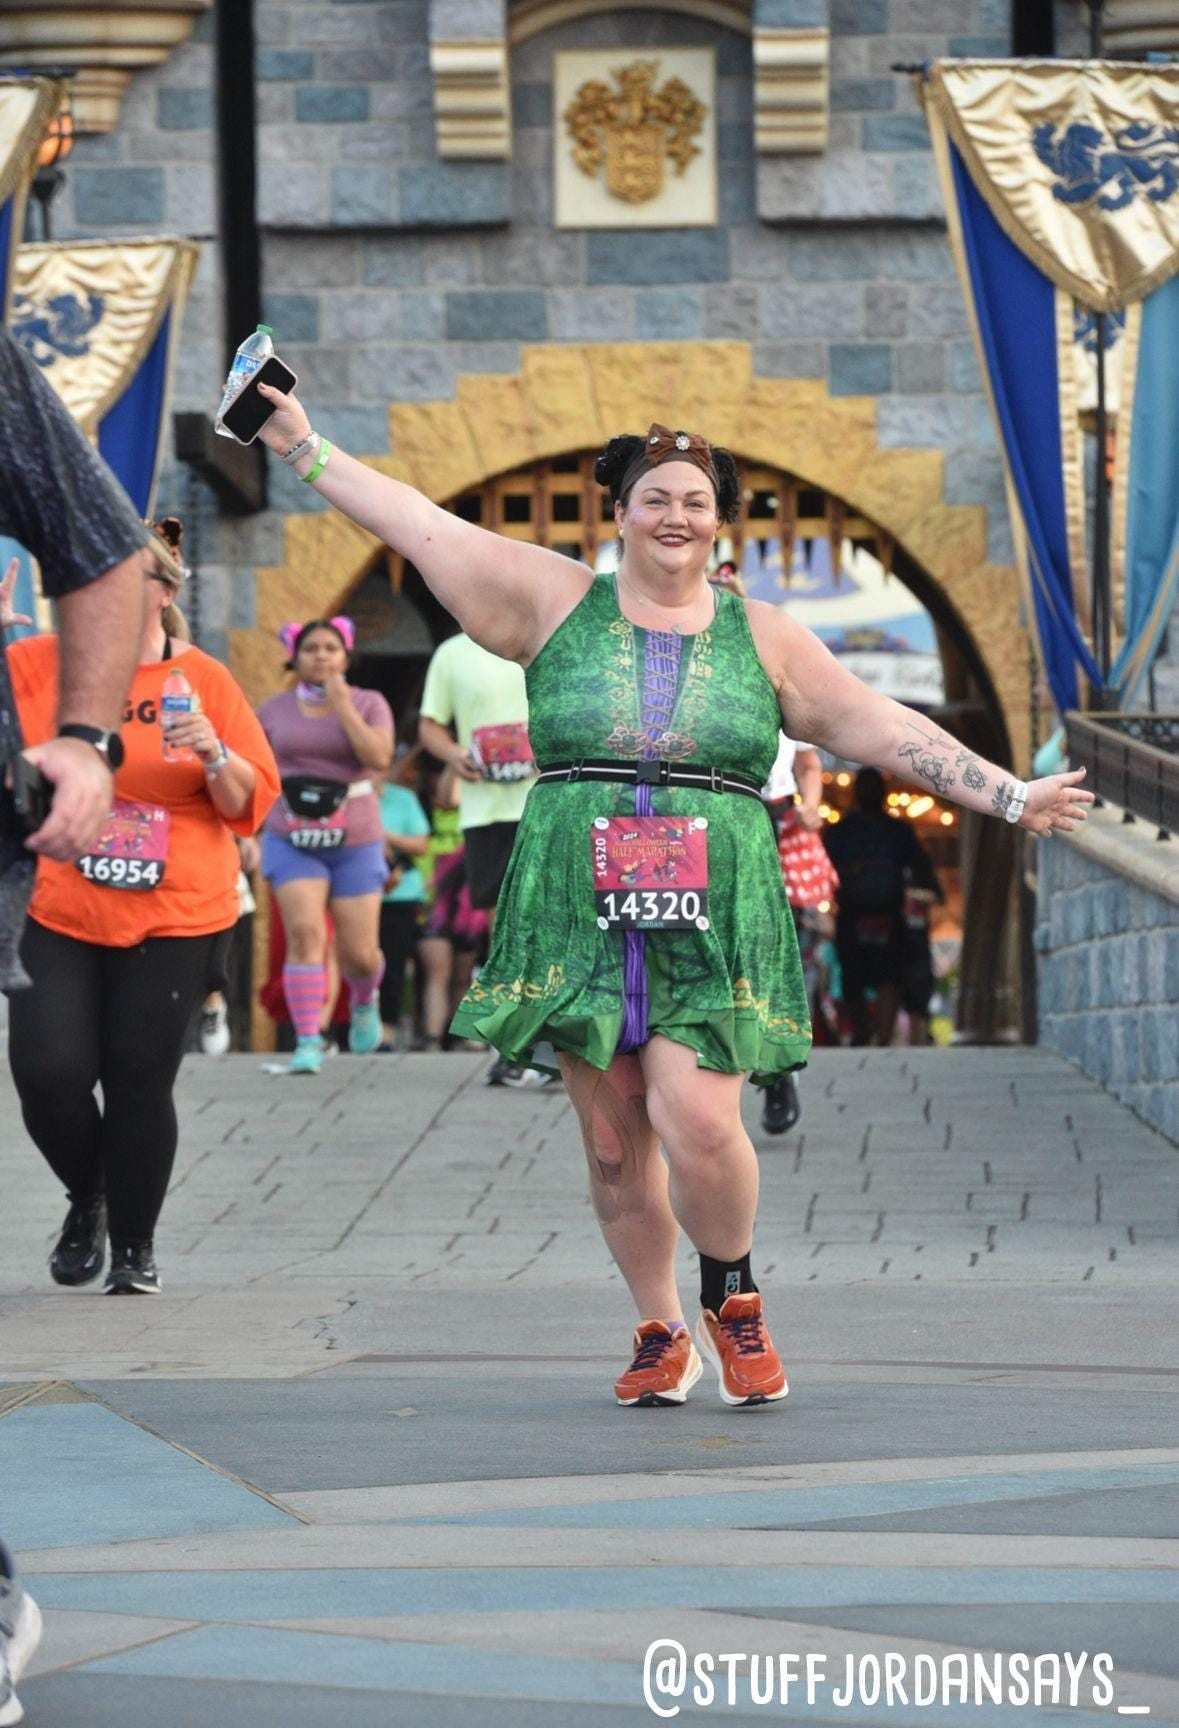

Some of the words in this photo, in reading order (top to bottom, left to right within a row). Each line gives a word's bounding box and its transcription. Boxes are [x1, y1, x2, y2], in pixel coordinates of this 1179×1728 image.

[595, 838, 607, 877] 14320
[612, 846, 634, 858] HALF
[637, 846, 687, 858] MARATHON
[79, 856, 160, 885] 16954
[603, 892, 700, 921] 14320
